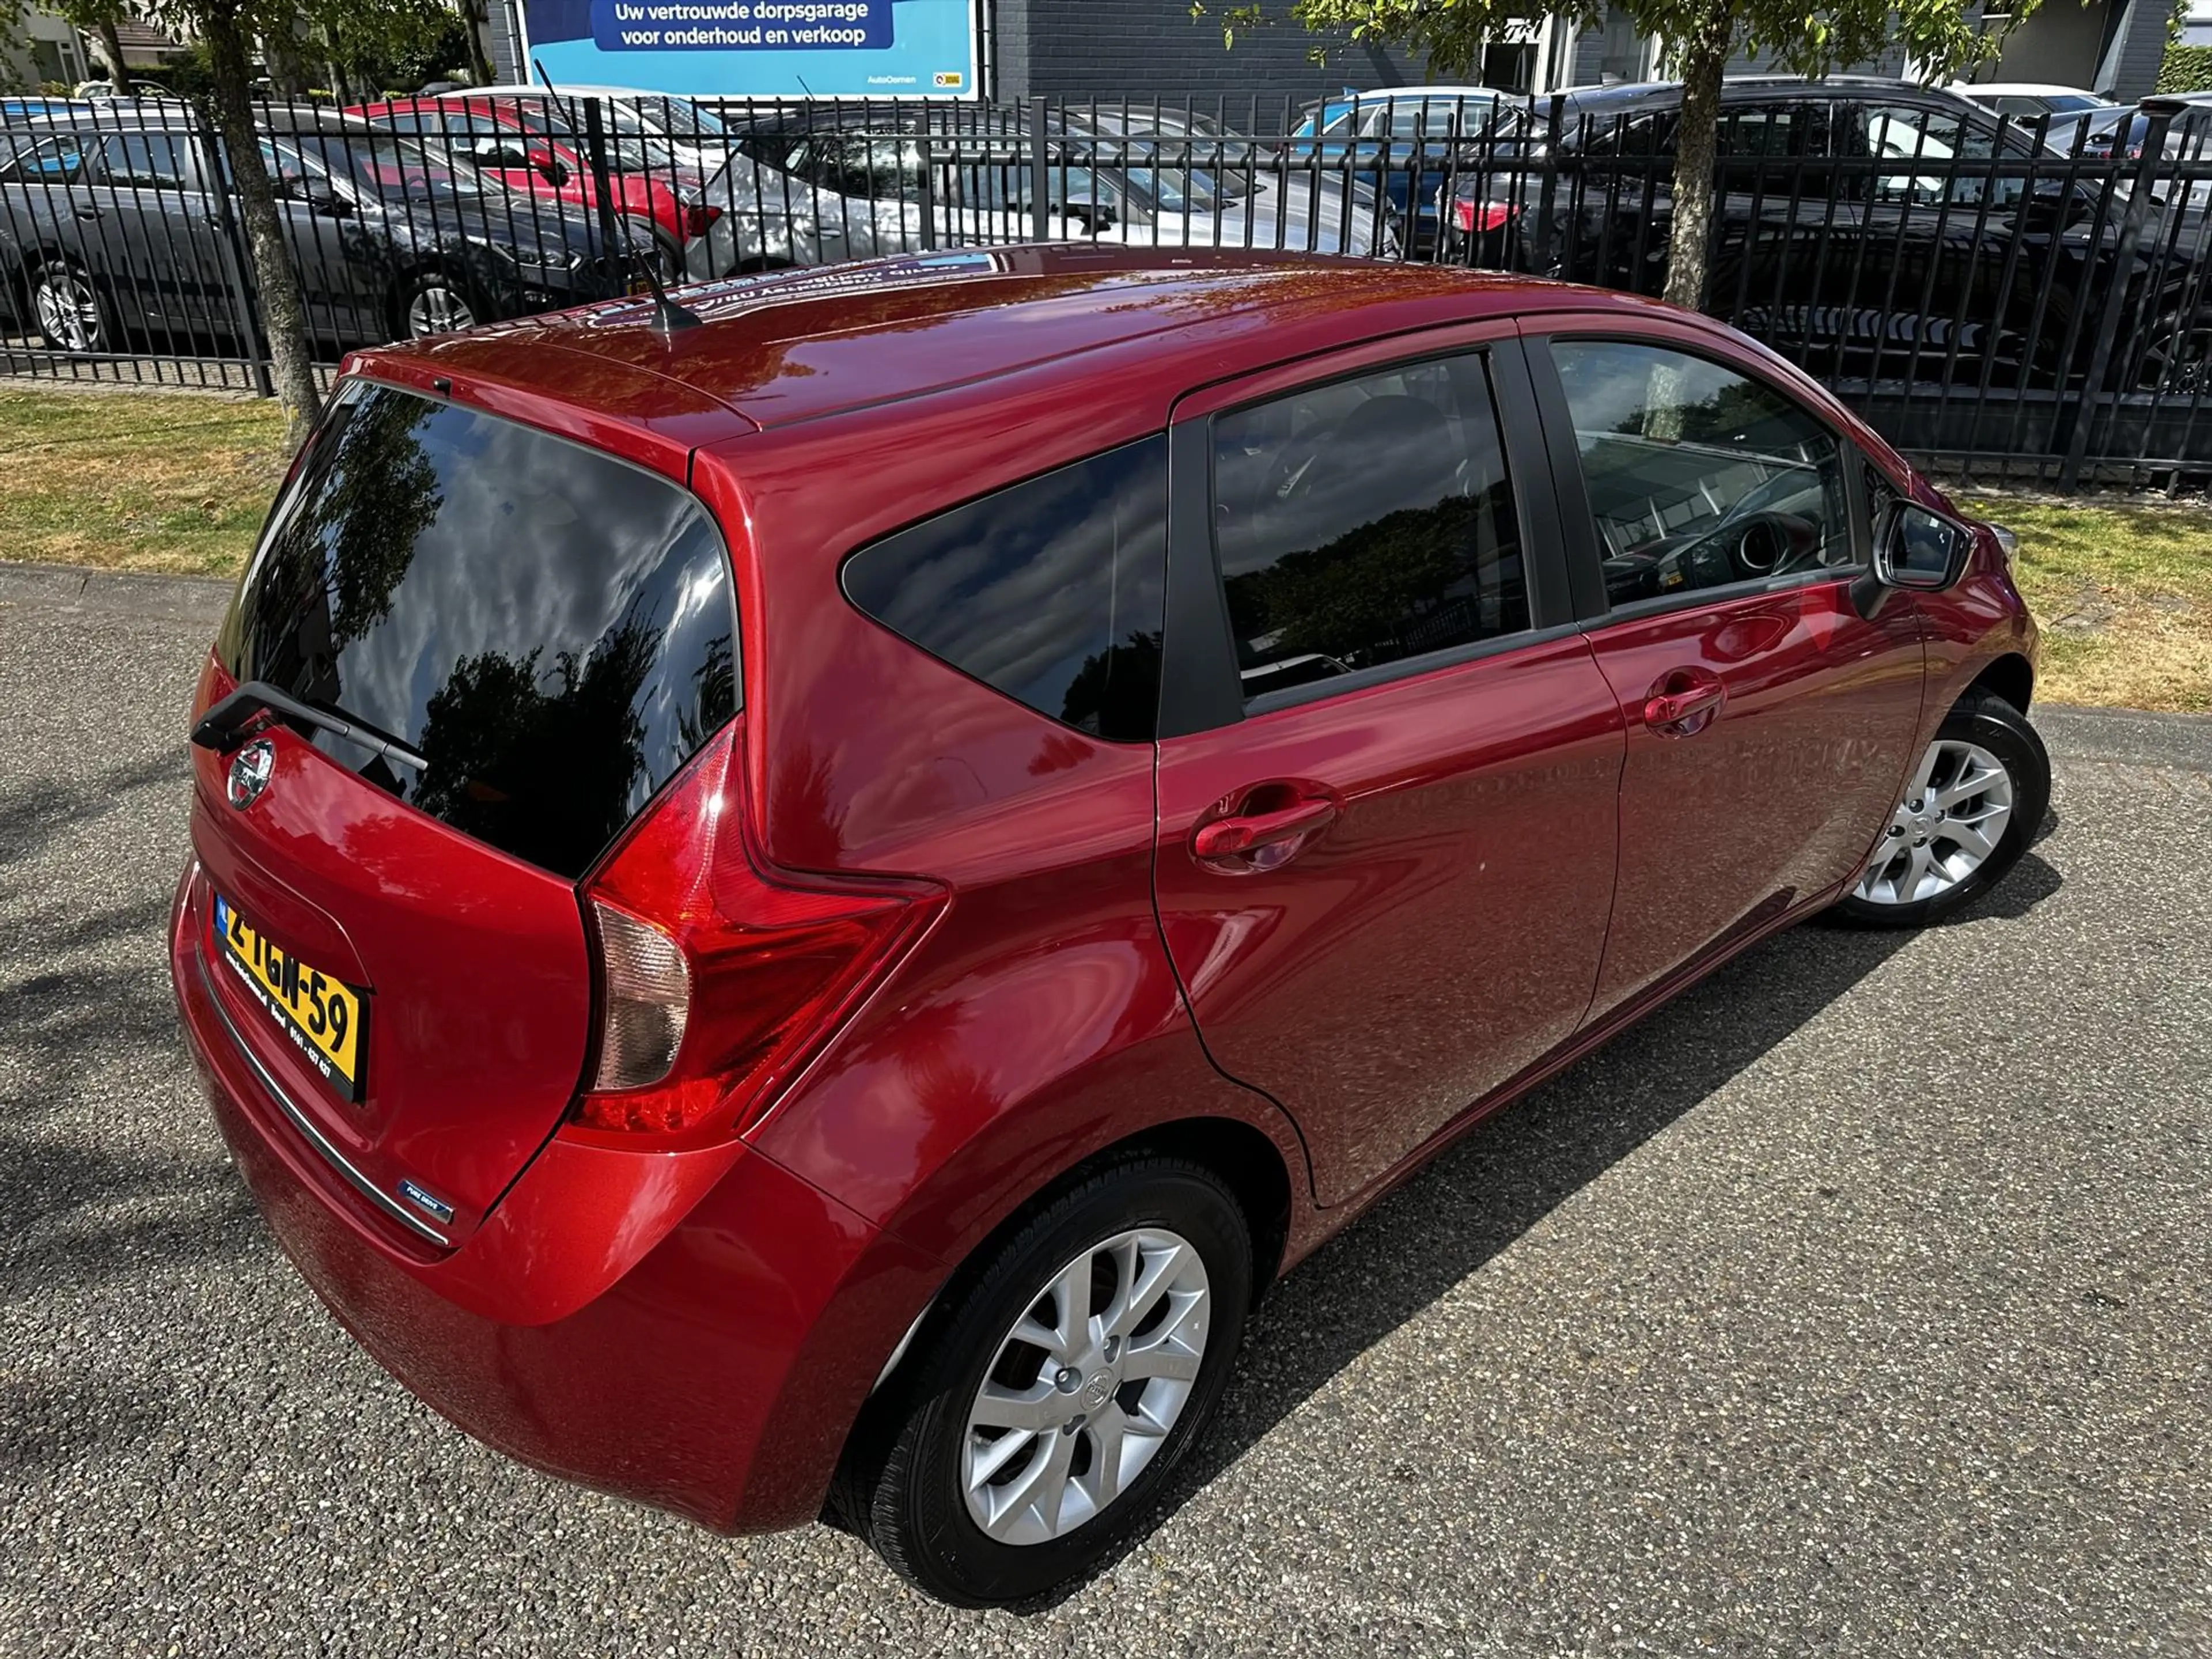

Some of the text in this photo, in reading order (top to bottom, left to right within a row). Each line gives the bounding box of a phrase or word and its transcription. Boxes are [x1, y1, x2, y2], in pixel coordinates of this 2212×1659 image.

[615, 2, 868, 22] Uw vertrouwde dorpsgarage
[622, 25, 866, 46] voor onderhoud en verkoop
[406, 1186, 438, 1210] PURE DRIVE
